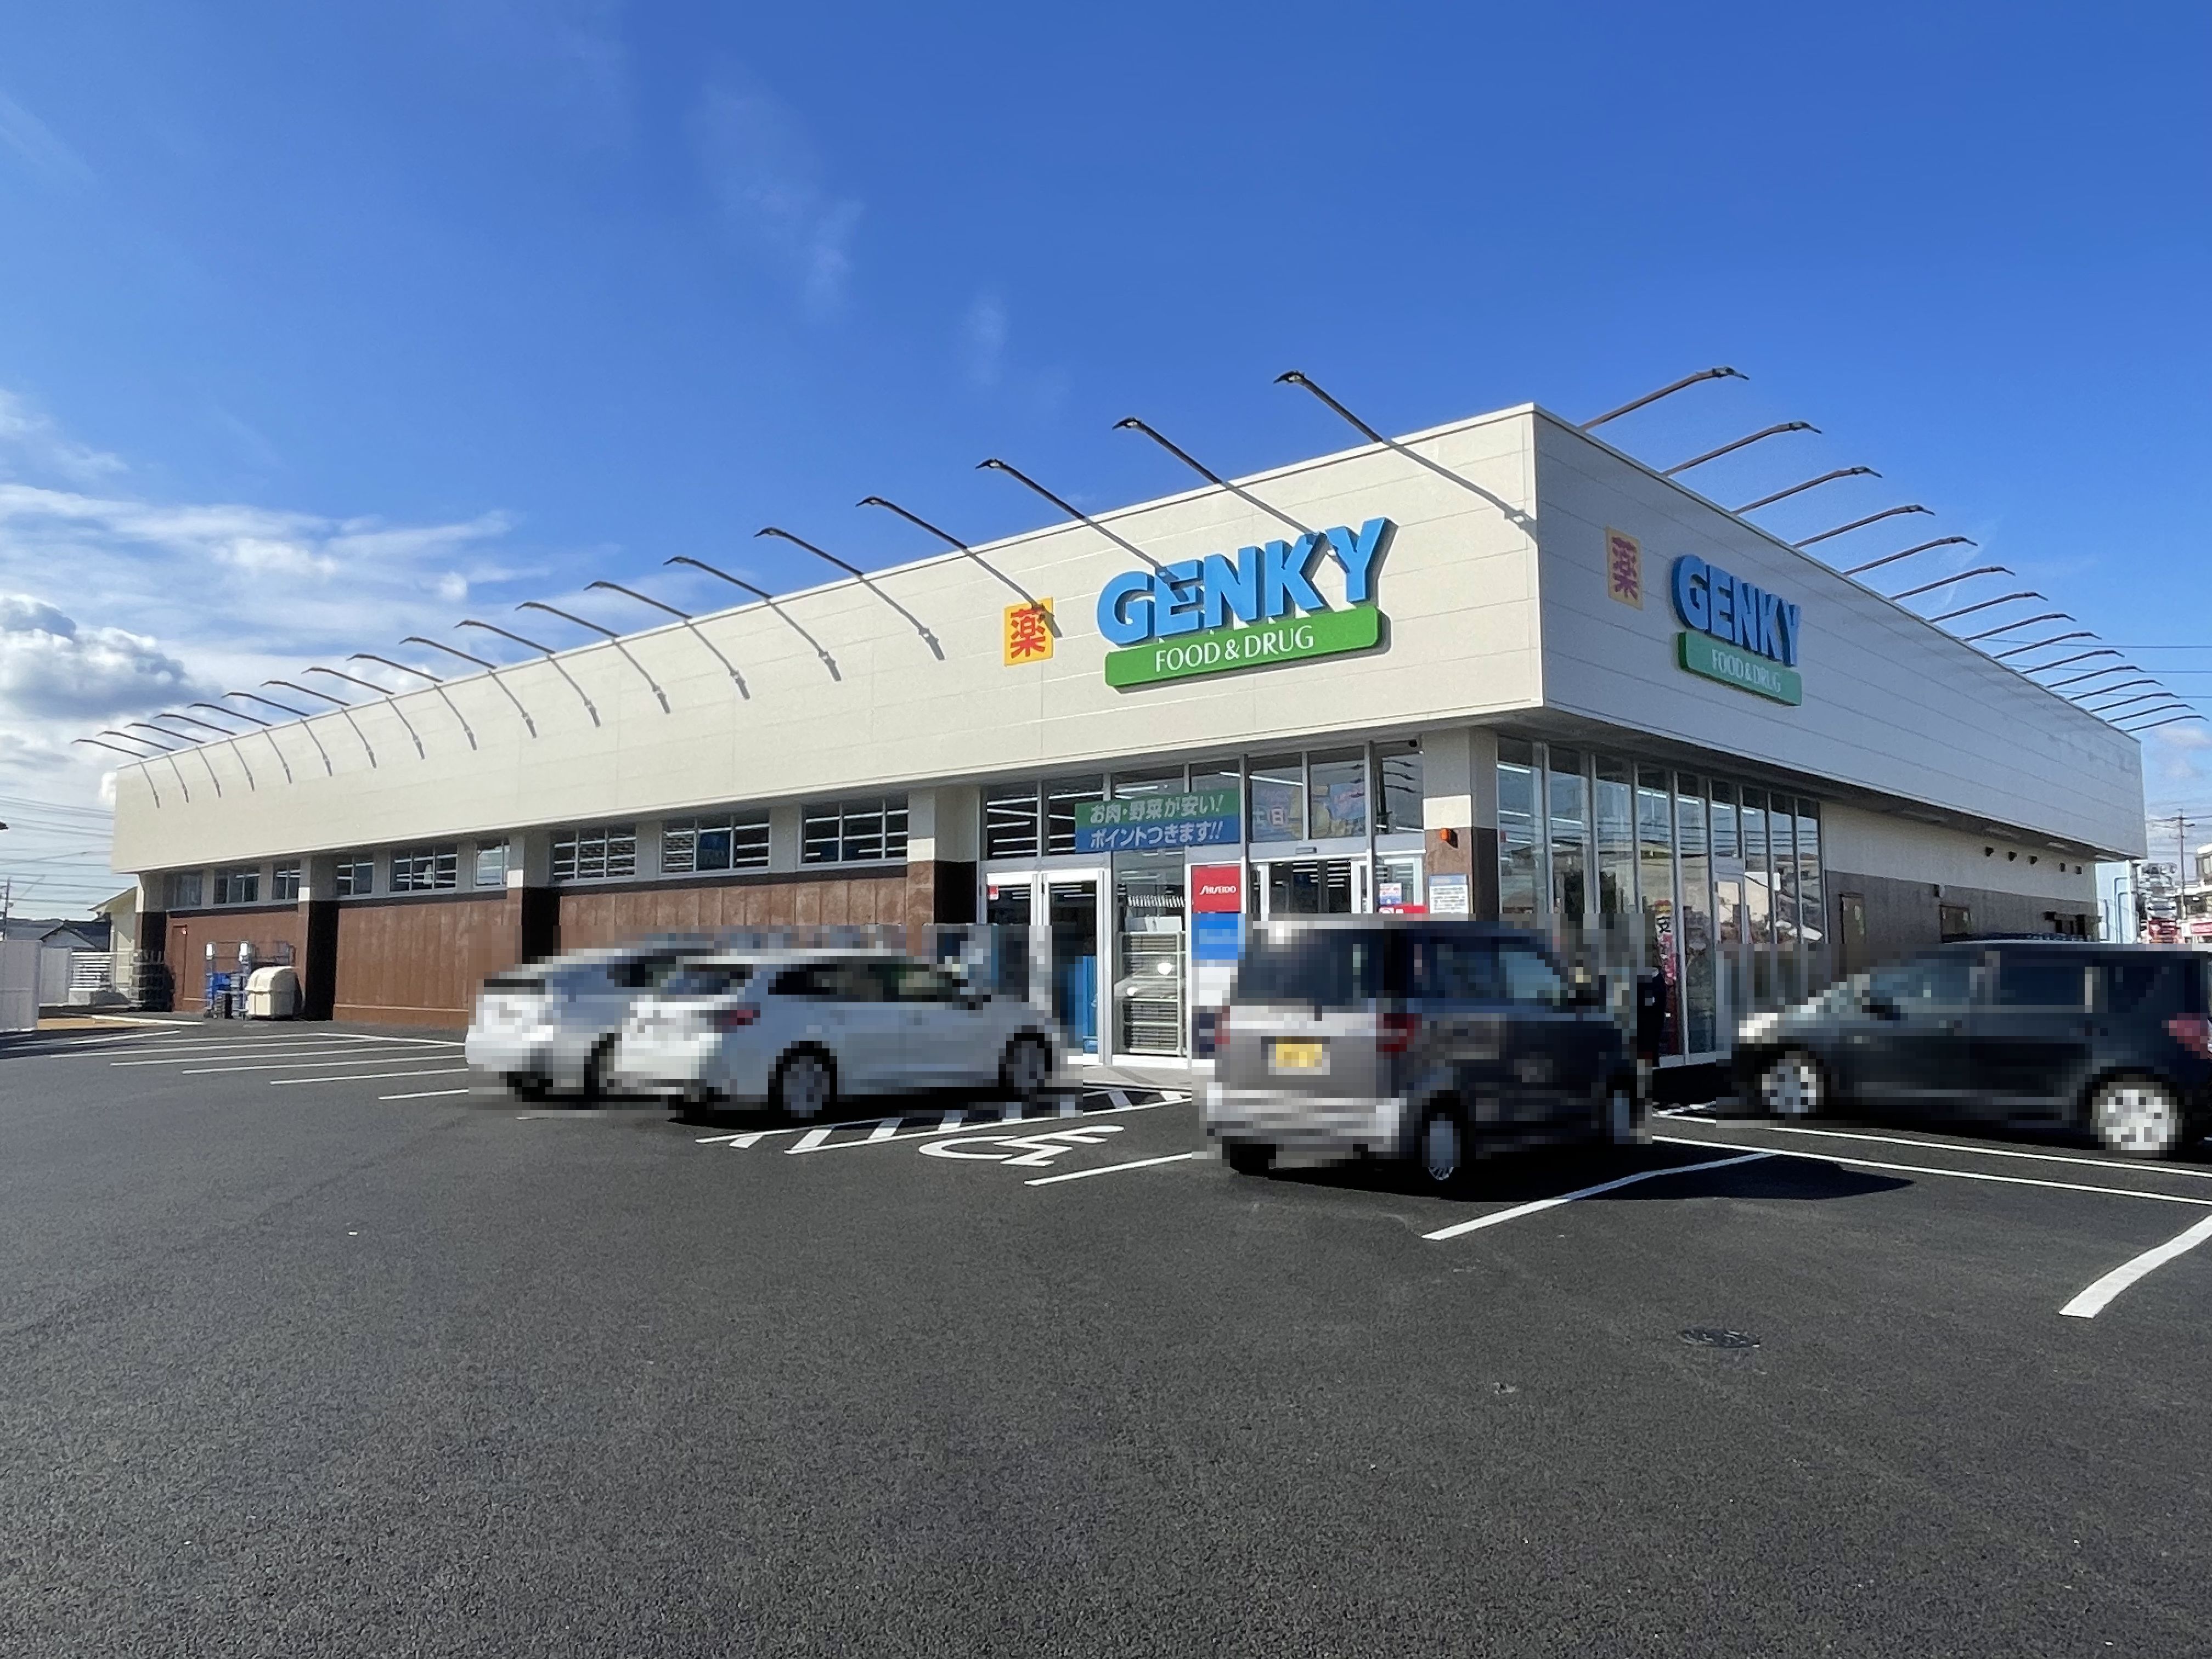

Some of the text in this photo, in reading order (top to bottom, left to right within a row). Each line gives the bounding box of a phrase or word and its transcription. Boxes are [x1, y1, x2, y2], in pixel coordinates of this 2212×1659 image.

[1097, 517, 1388, 645] GENKY
[1010, 608, 1046, 658] 薬
[1672, 554, 1801, 667] GENKY
[1155, 625, 1314, 673] FOOD & DRUG
[1711, 648, 1743, 679] FOOD
[1753, 664, 1781, 693] DRUG
